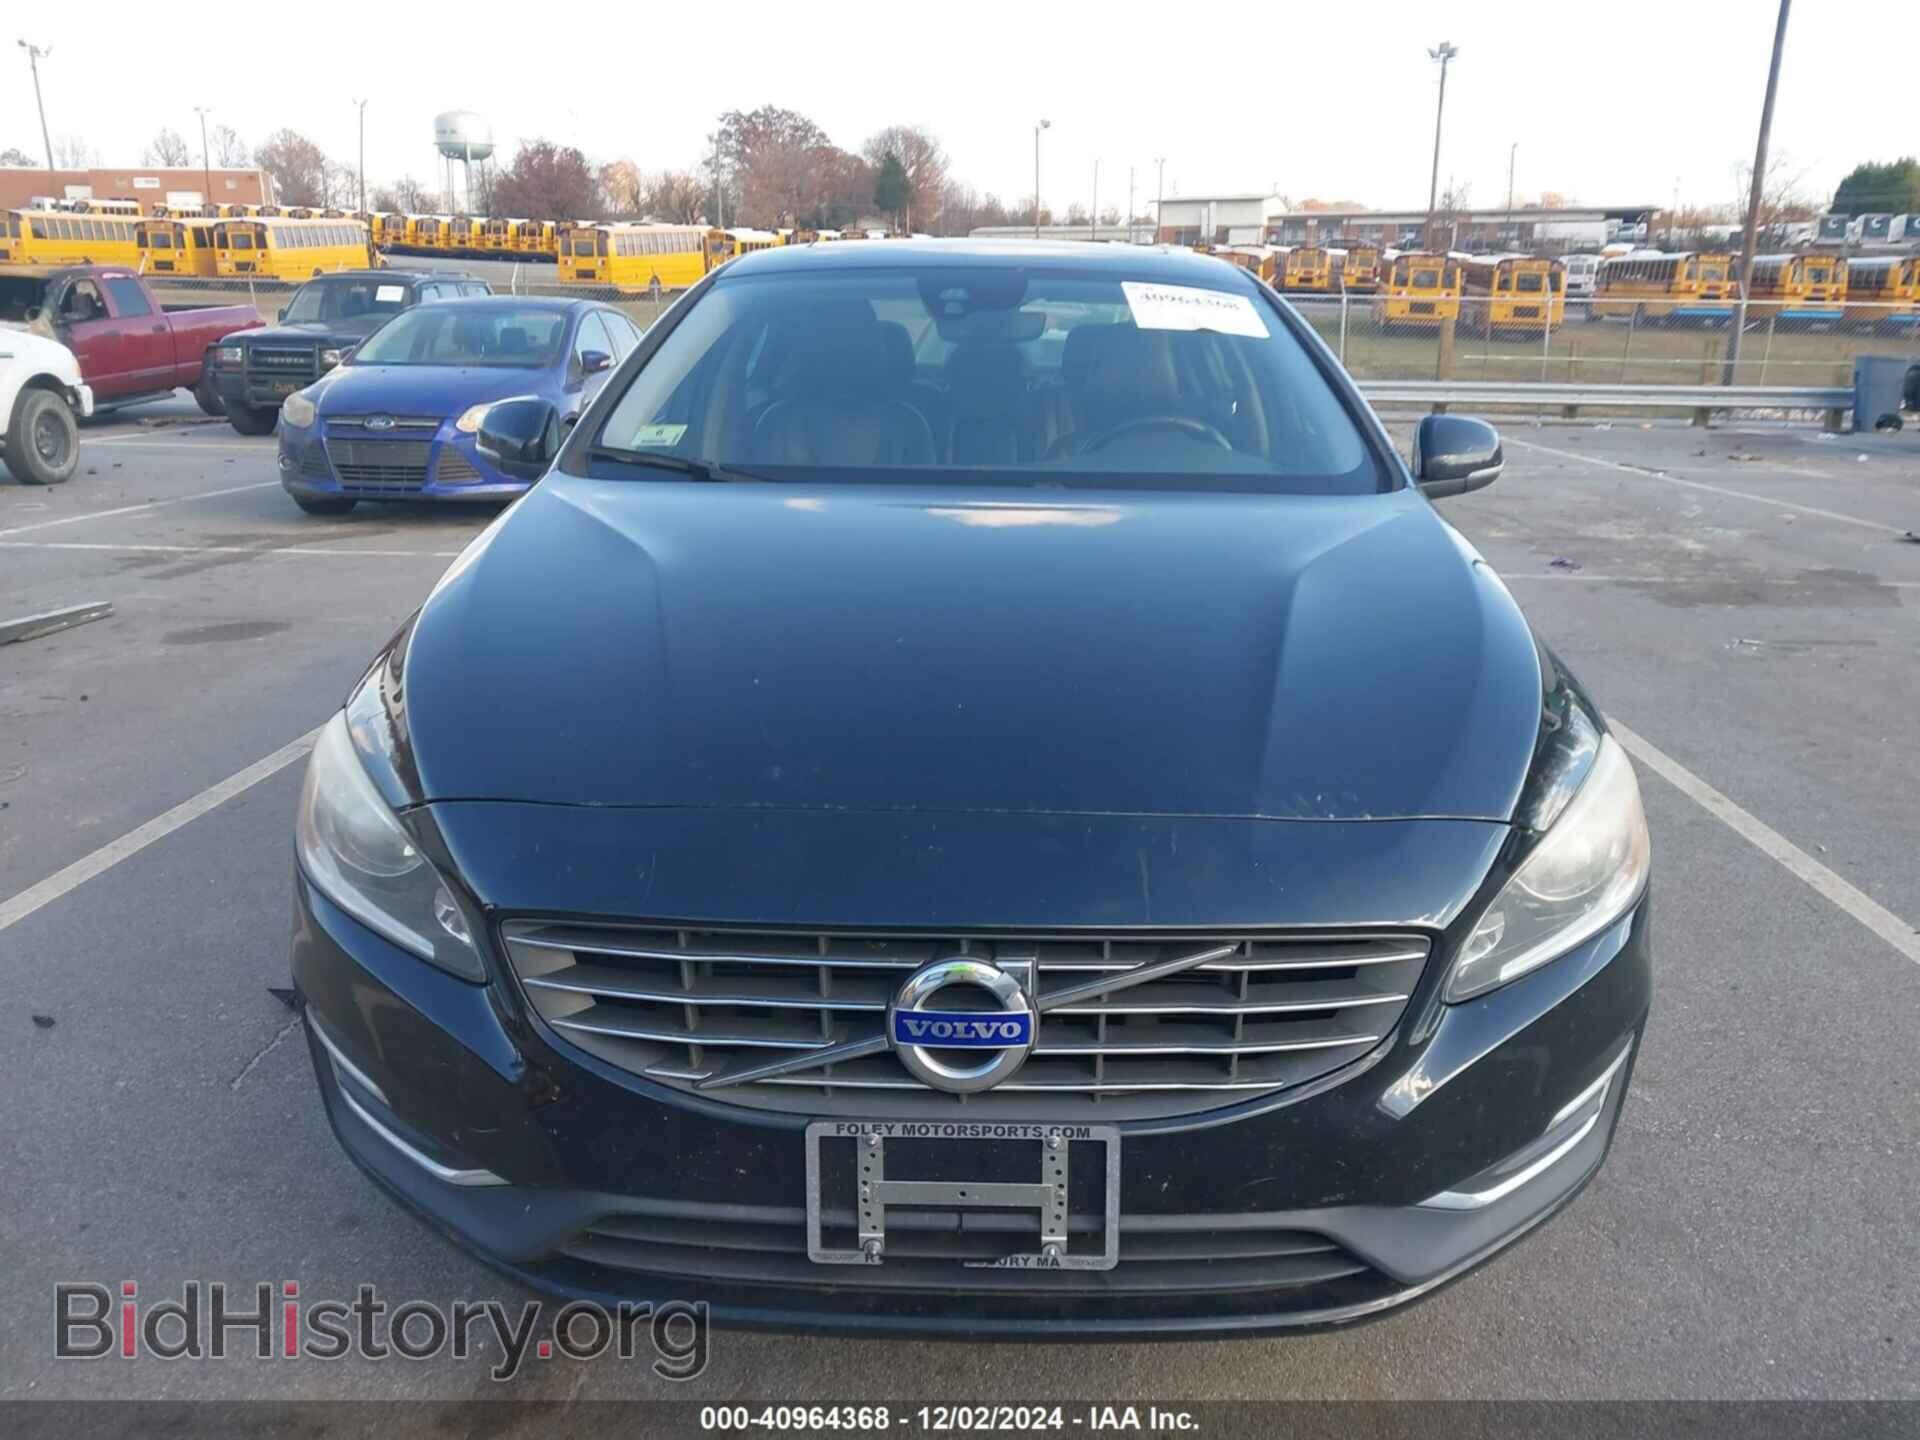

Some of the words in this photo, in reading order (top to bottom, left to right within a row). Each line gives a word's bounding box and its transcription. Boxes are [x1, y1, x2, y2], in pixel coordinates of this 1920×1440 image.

[902, 1019, 1022, 1039] VOLVO
[836, 1123, 895, 1136] FOLEY
[901, 1124, 1091, 1139] MOTORSPORTS.COM
